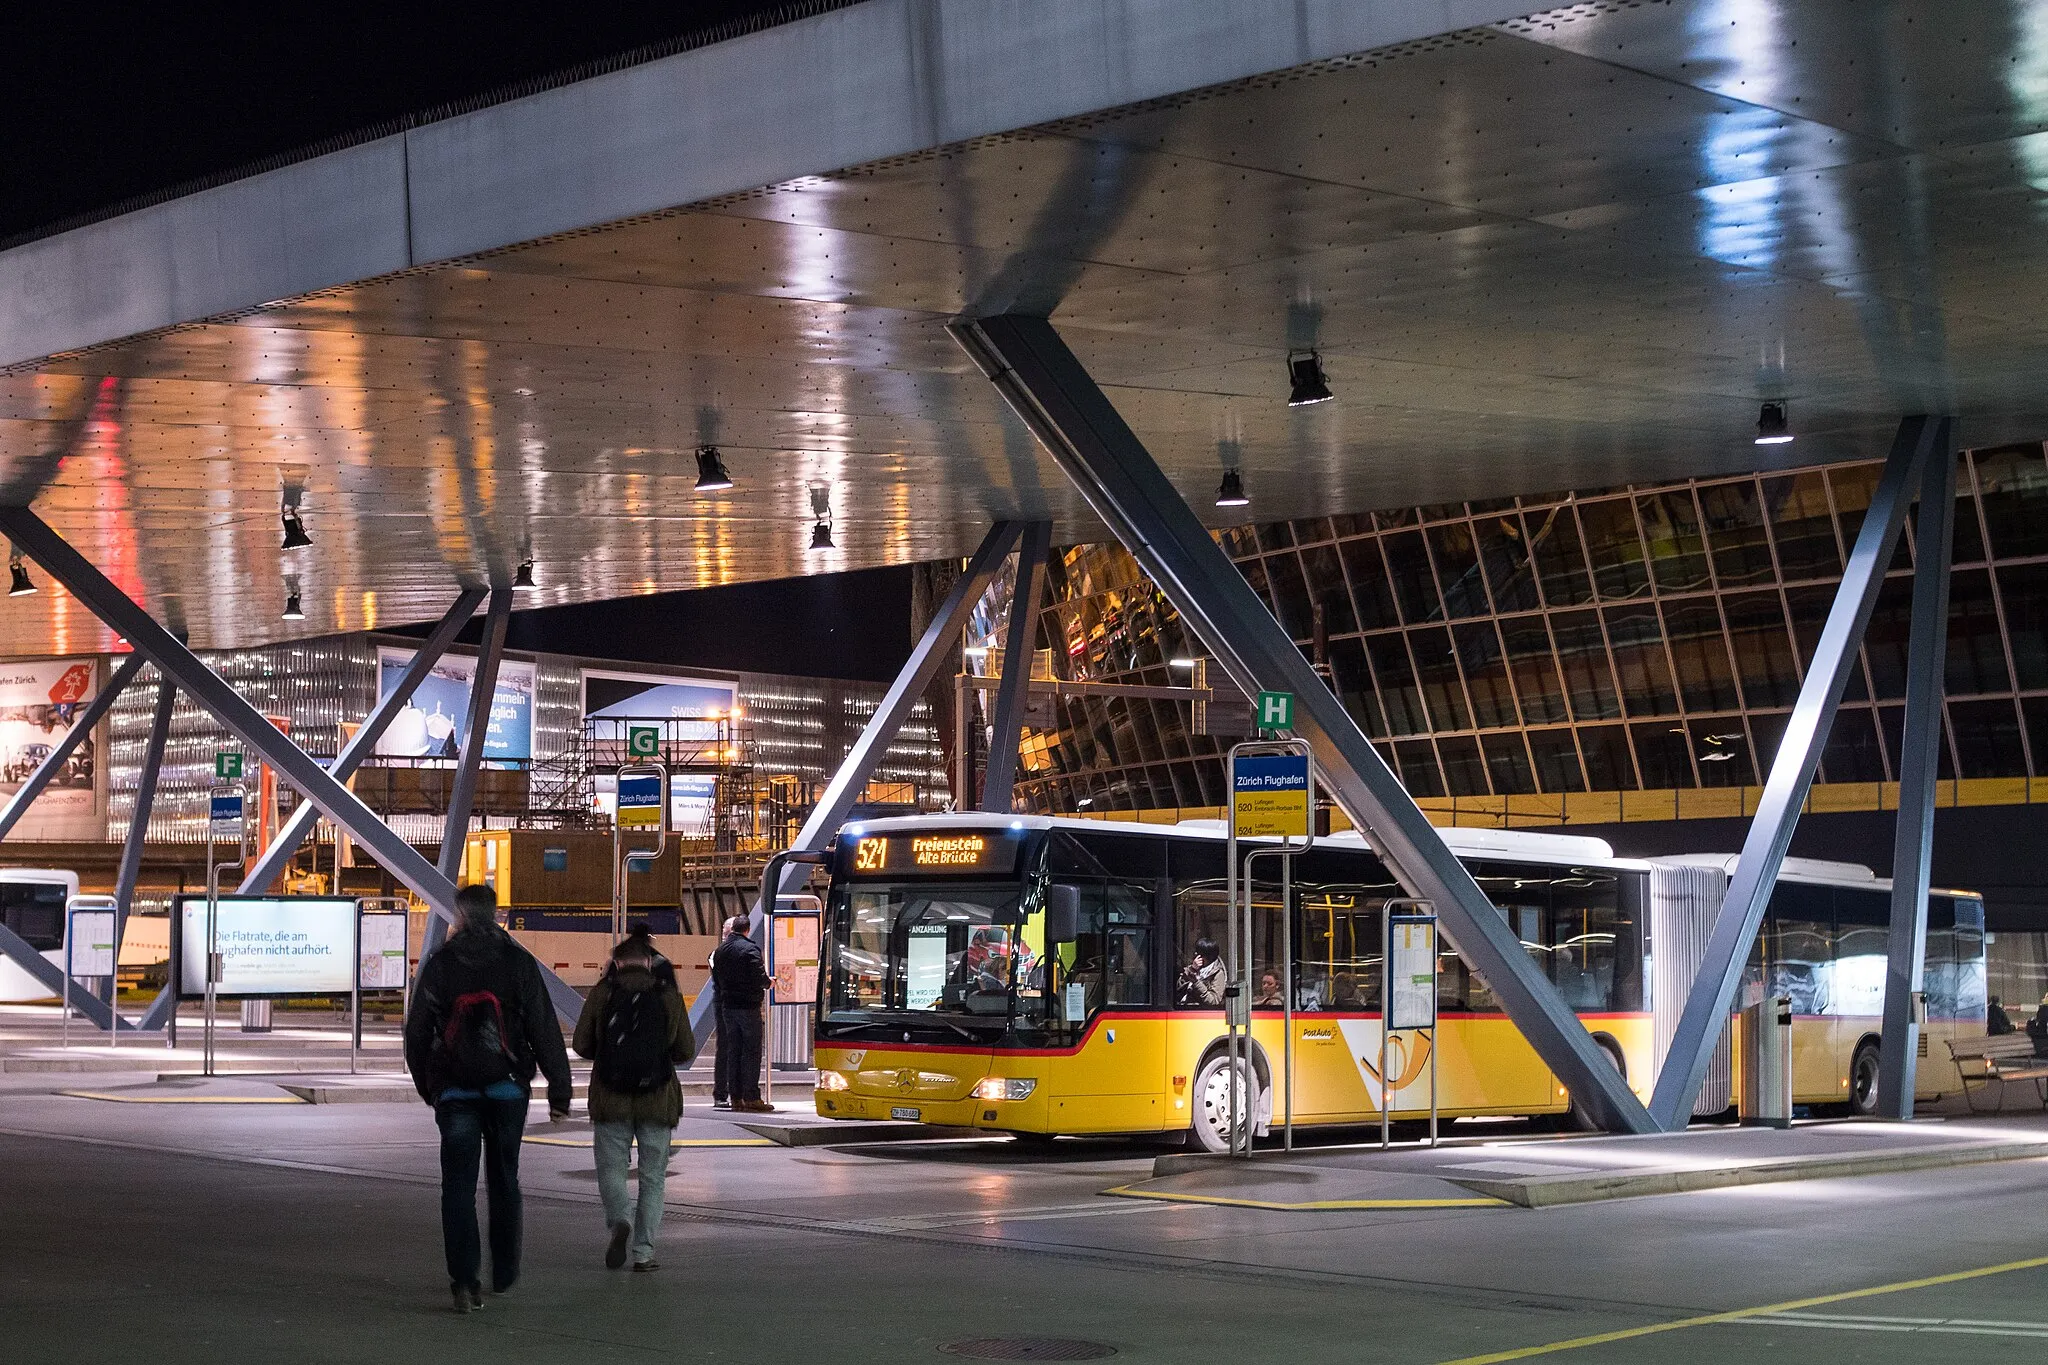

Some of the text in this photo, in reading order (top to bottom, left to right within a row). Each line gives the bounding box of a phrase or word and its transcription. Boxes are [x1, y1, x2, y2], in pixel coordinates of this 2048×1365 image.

[494, 692, 525, 704] mmeln
[671, 705, 701, 717] SWISS
[1264, 697, 1286, 723] H
[489, 724, 502, 733] en.
[634, 731, 653, 752] G
[223, 756, 236, 774] F
[1237, 775, 1304, 786] Zürich Flughafen
[620, 794, 659, 803] Zürich Flughafen
[1238, 803, 1252, 812] 520
[1238, 827, 1252, 835] 524
[913, 836, 983, 852] Freienstein
[857, 838, 888, 868] 521
[917, 851, 977, 864] Alte Brücke
[911, 925, 947, 934] ANZAHLUNG
[233, 930, 273, 942] Flatrate,
[274, 930, 290, 941] die
[265, 944, 290, 955] nicht
[292, 944, 332, 955] aufhört.
[1303, 1028, 1331, 1037] PostAuto
